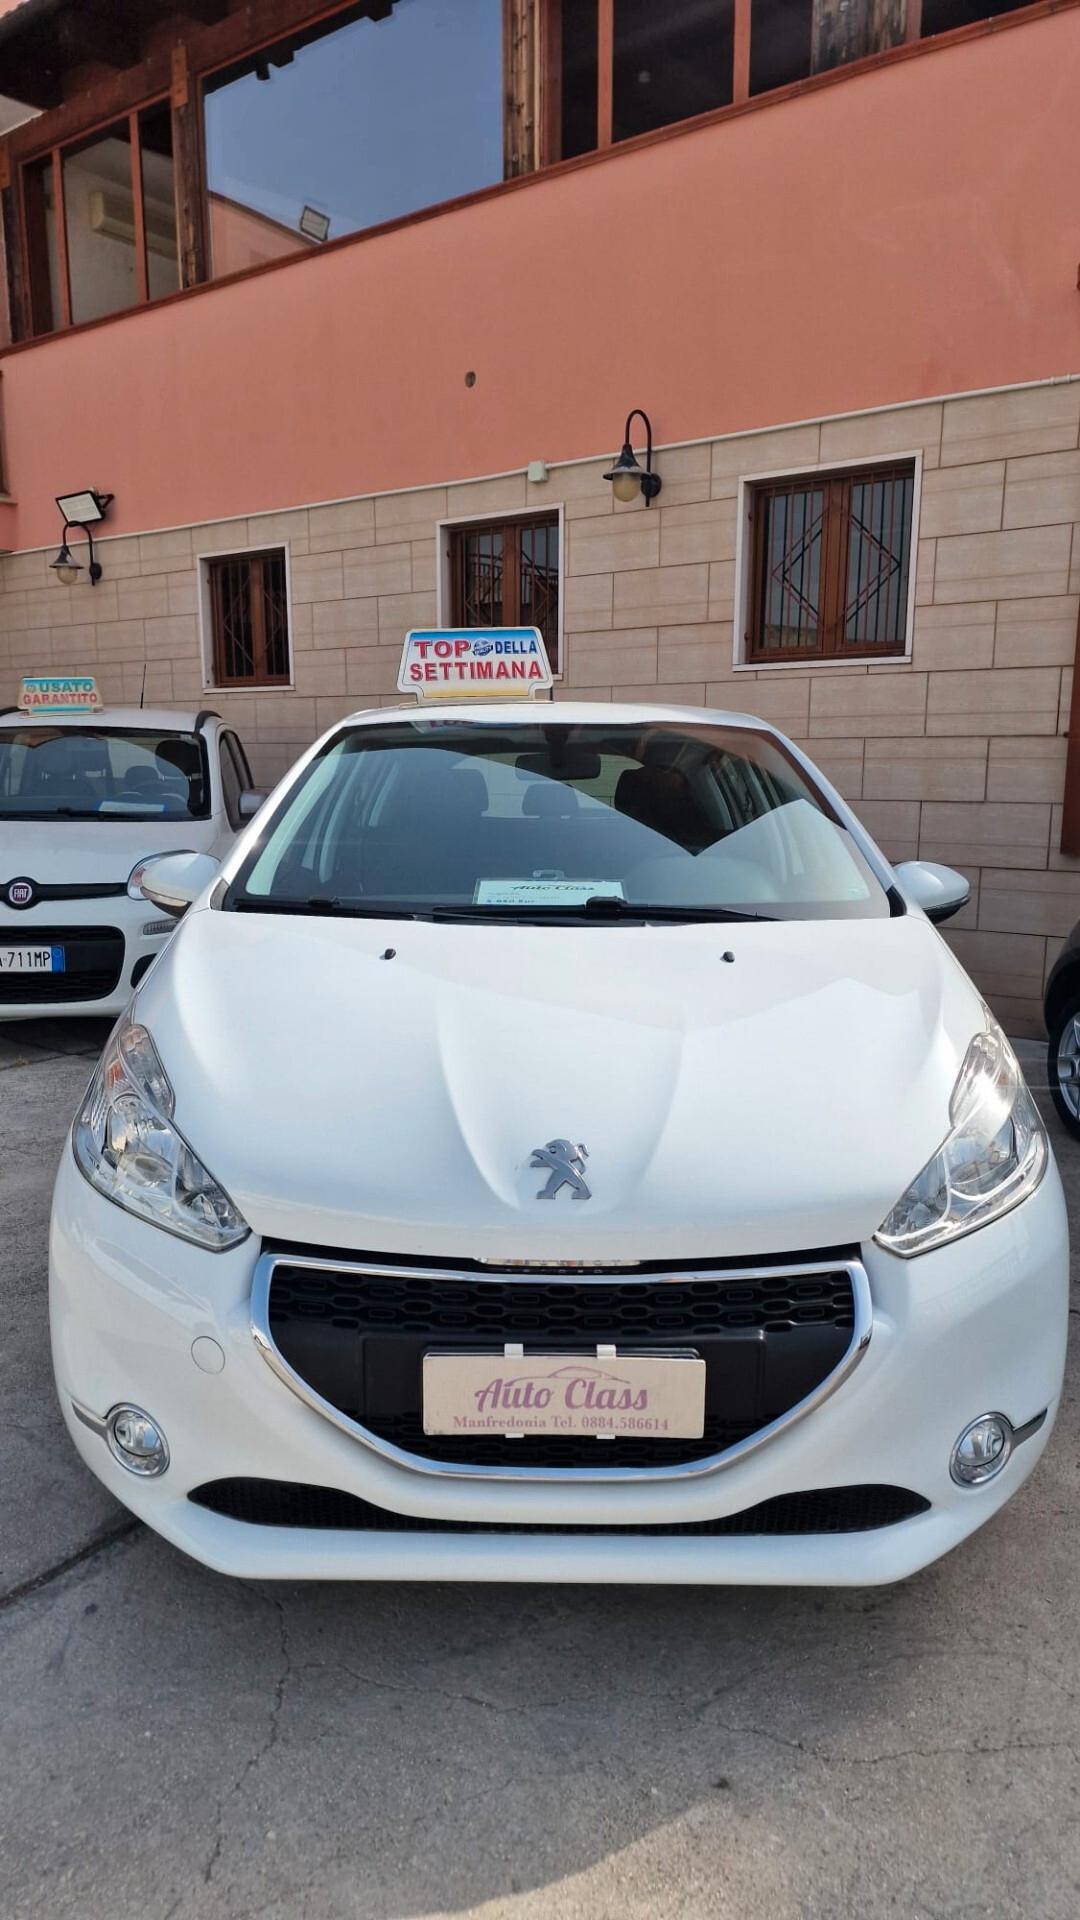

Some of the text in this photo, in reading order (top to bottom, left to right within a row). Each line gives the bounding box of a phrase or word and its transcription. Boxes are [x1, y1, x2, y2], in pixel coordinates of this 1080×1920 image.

[414, 640, 471, 659] TOP
[495, 640, 537, 654] DELLA
[410, 660, 543, 681] SETTIMANA
[40, 682, 93, 692] USATO
[23, 693, 97, 704] GARANTITO
[13, 888, 28, 899] FIAT
[474, 1378, 648, 1412] Auto Class
[453, 1415, 669, 1431] Manfredonia Tel. 0884.586614
